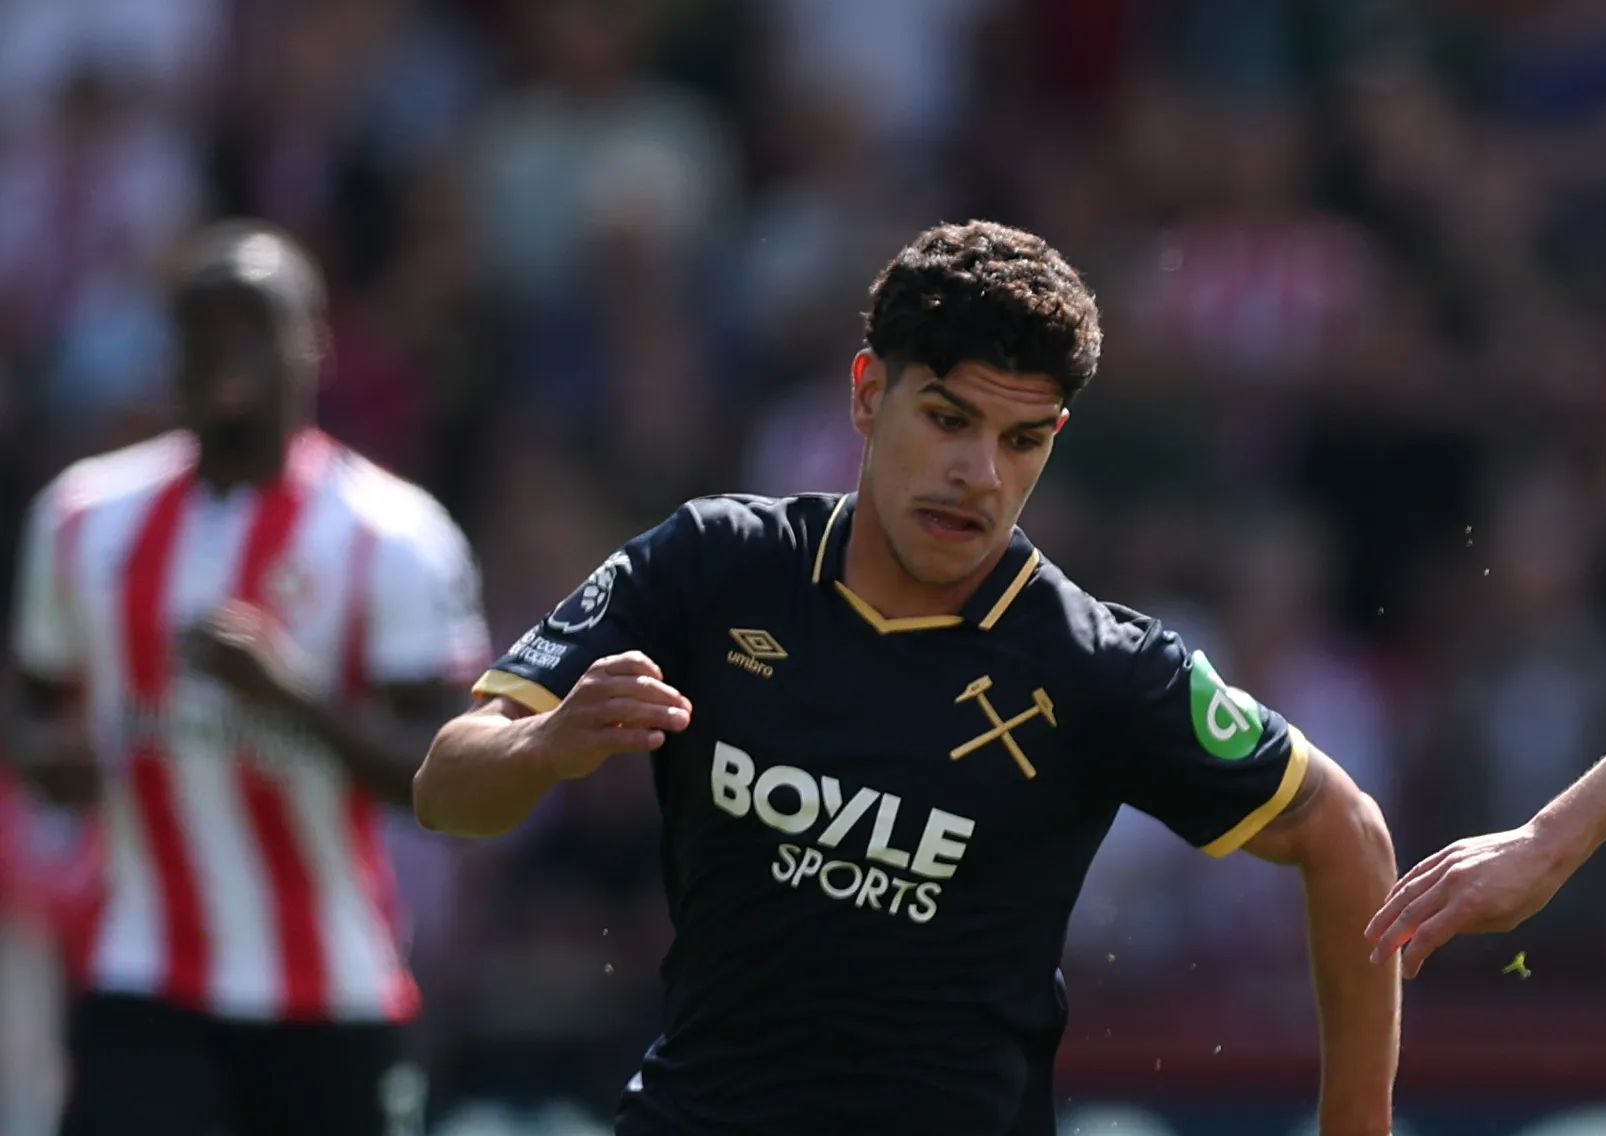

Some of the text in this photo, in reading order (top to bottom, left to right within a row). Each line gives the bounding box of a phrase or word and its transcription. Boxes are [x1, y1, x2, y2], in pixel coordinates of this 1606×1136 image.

[727, 650, 774, 679] umbro
[710, 740, 976, 880] BOYLE
[771, 843, 943, 923] SPORTS
